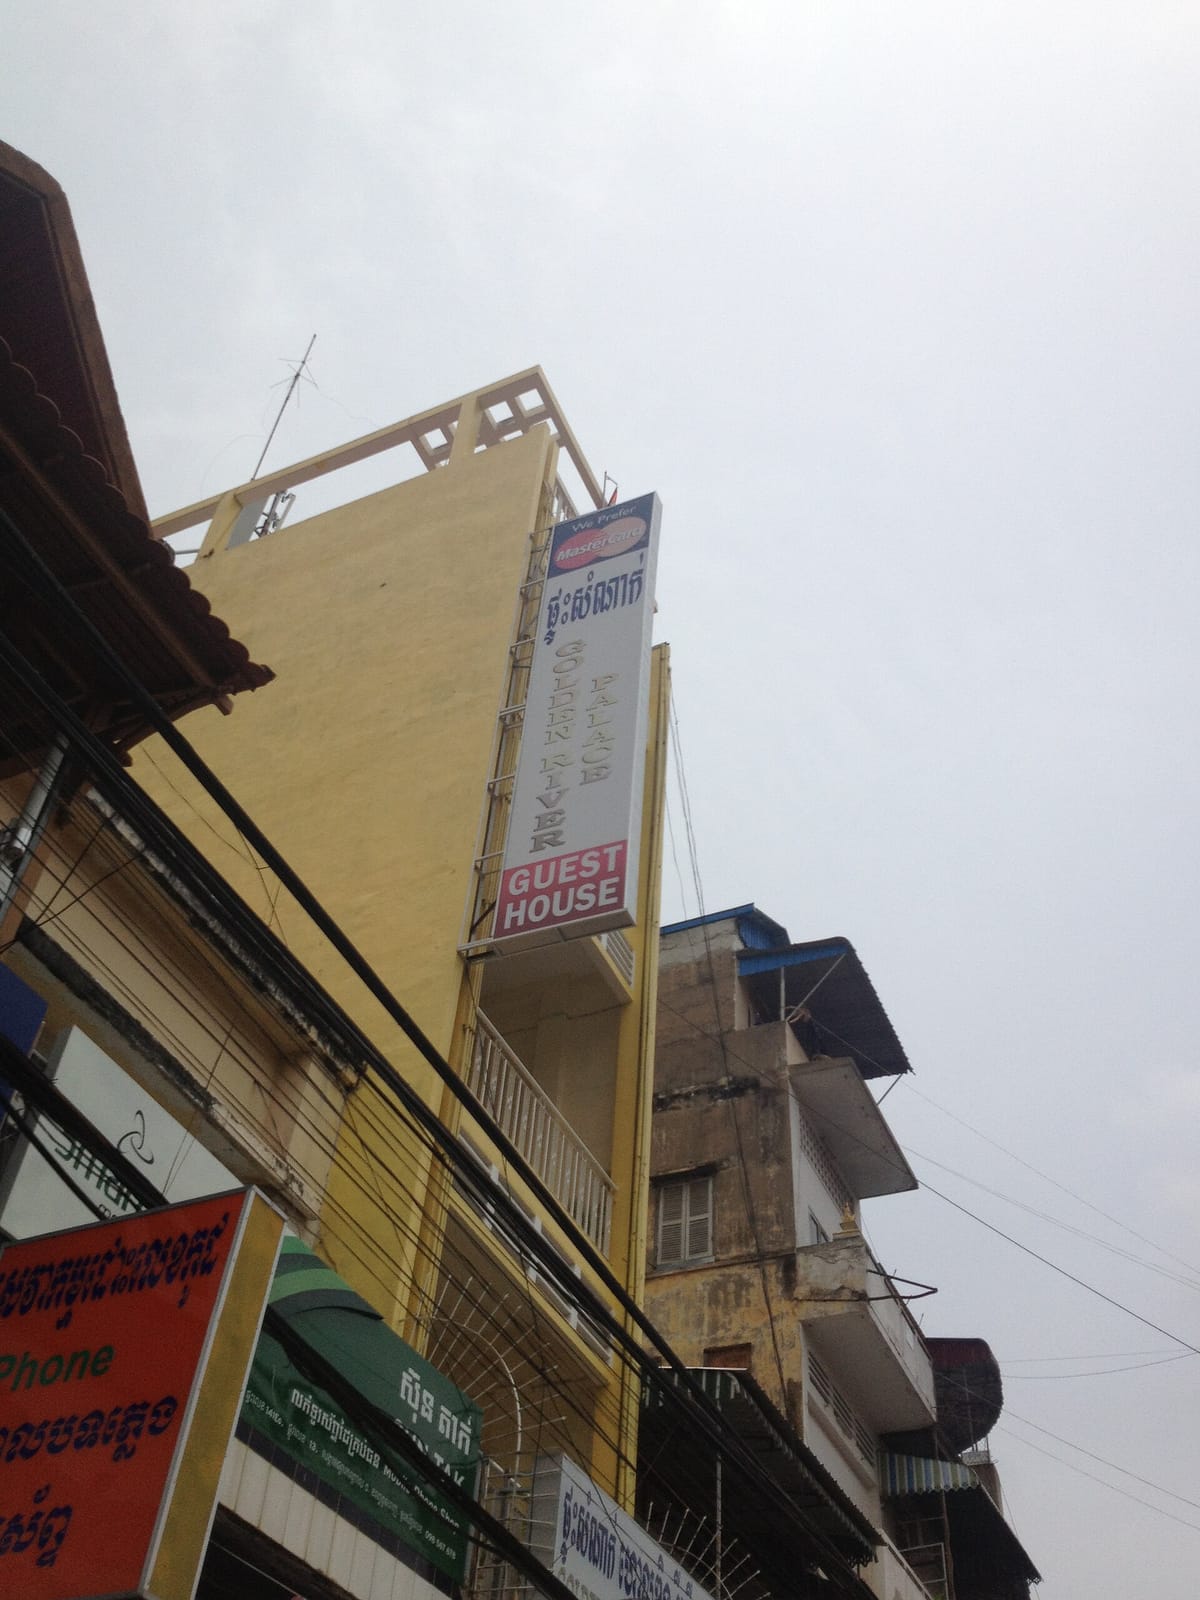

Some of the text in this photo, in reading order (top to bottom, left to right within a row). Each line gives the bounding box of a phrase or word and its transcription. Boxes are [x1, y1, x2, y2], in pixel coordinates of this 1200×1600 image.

[556, 526, 643, 562] MasterCard
[572, 505, 637, 533] We Prefer
[529, 639, 587, 853] GOLDEN RIVER
[579, 672, 620, 786] PALACE
[508, 843, 623, 896] GUEST
[503, 877, 620, 930] HOUSE
